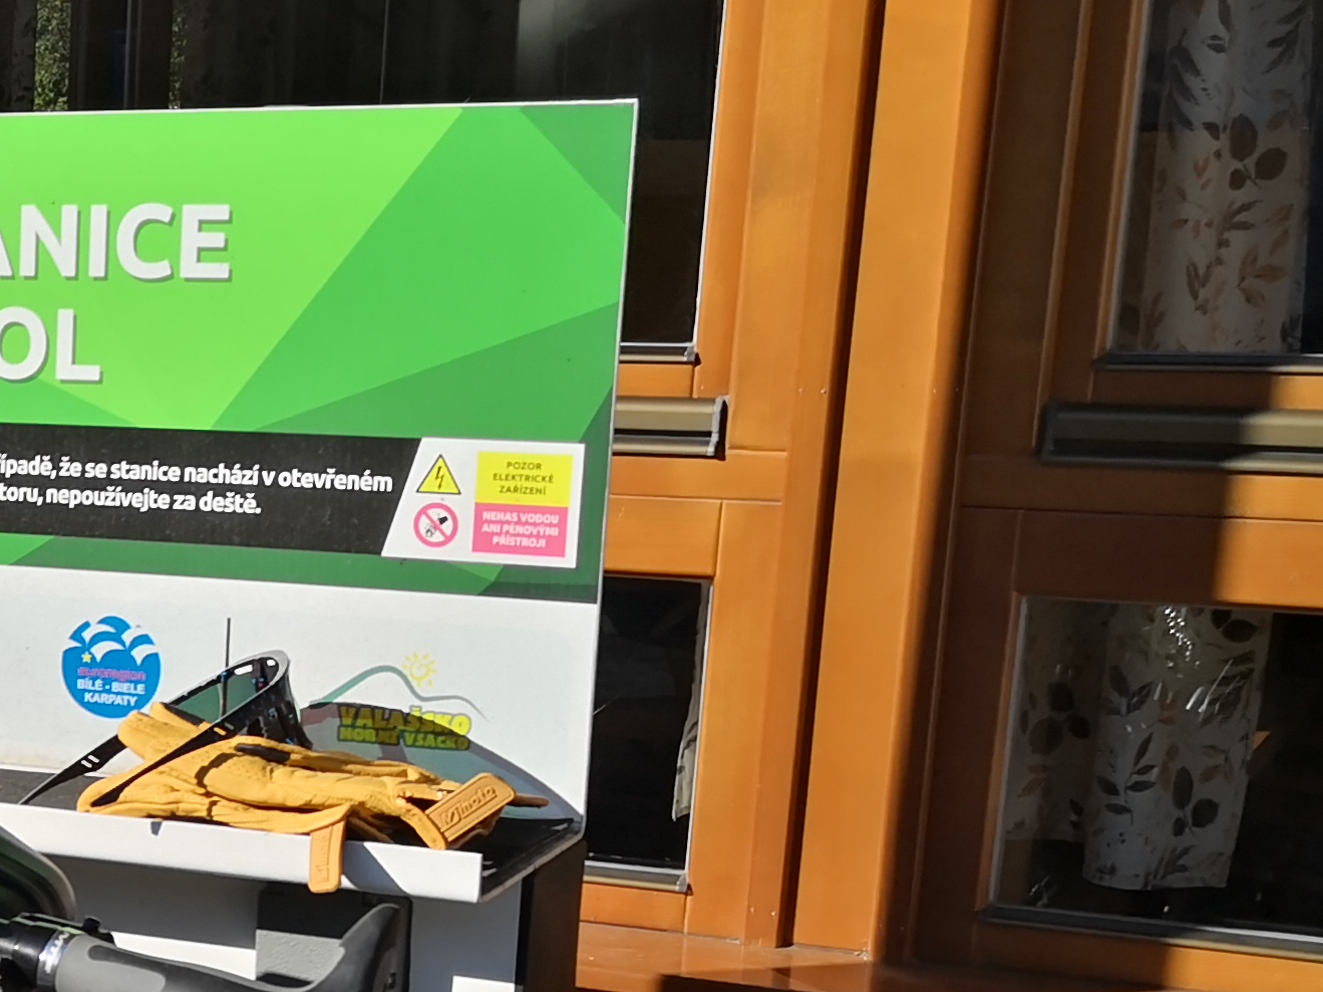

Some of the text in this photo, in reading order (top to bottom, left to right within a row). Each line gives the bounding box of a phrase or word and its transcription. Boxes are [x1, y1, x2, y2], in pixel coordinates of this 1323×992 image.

[506, 461, 542, 471] POZOR
[58, 455, 81, 478] že
[84, 463, 107, 479] se
[110, 460, 181, 482] stanice
[183, 462, 260, 486] nachází
[261, 470, 276, 486] v
[277, 467, 393, 492] otevřeném
[493, 472, 555, 484] ELEKTRICKÉ
[45, 485, 171, 513] nepoužívejte
[173, 493, 196, 511] za
[199, 489, 263, 515] deště.
[520, 512, 559, 525] VODOU
[481, 524, 501, 534] ANI
[111, 681, 146, 695] BIELE
[84, 691, 138, 707] KARPATY
